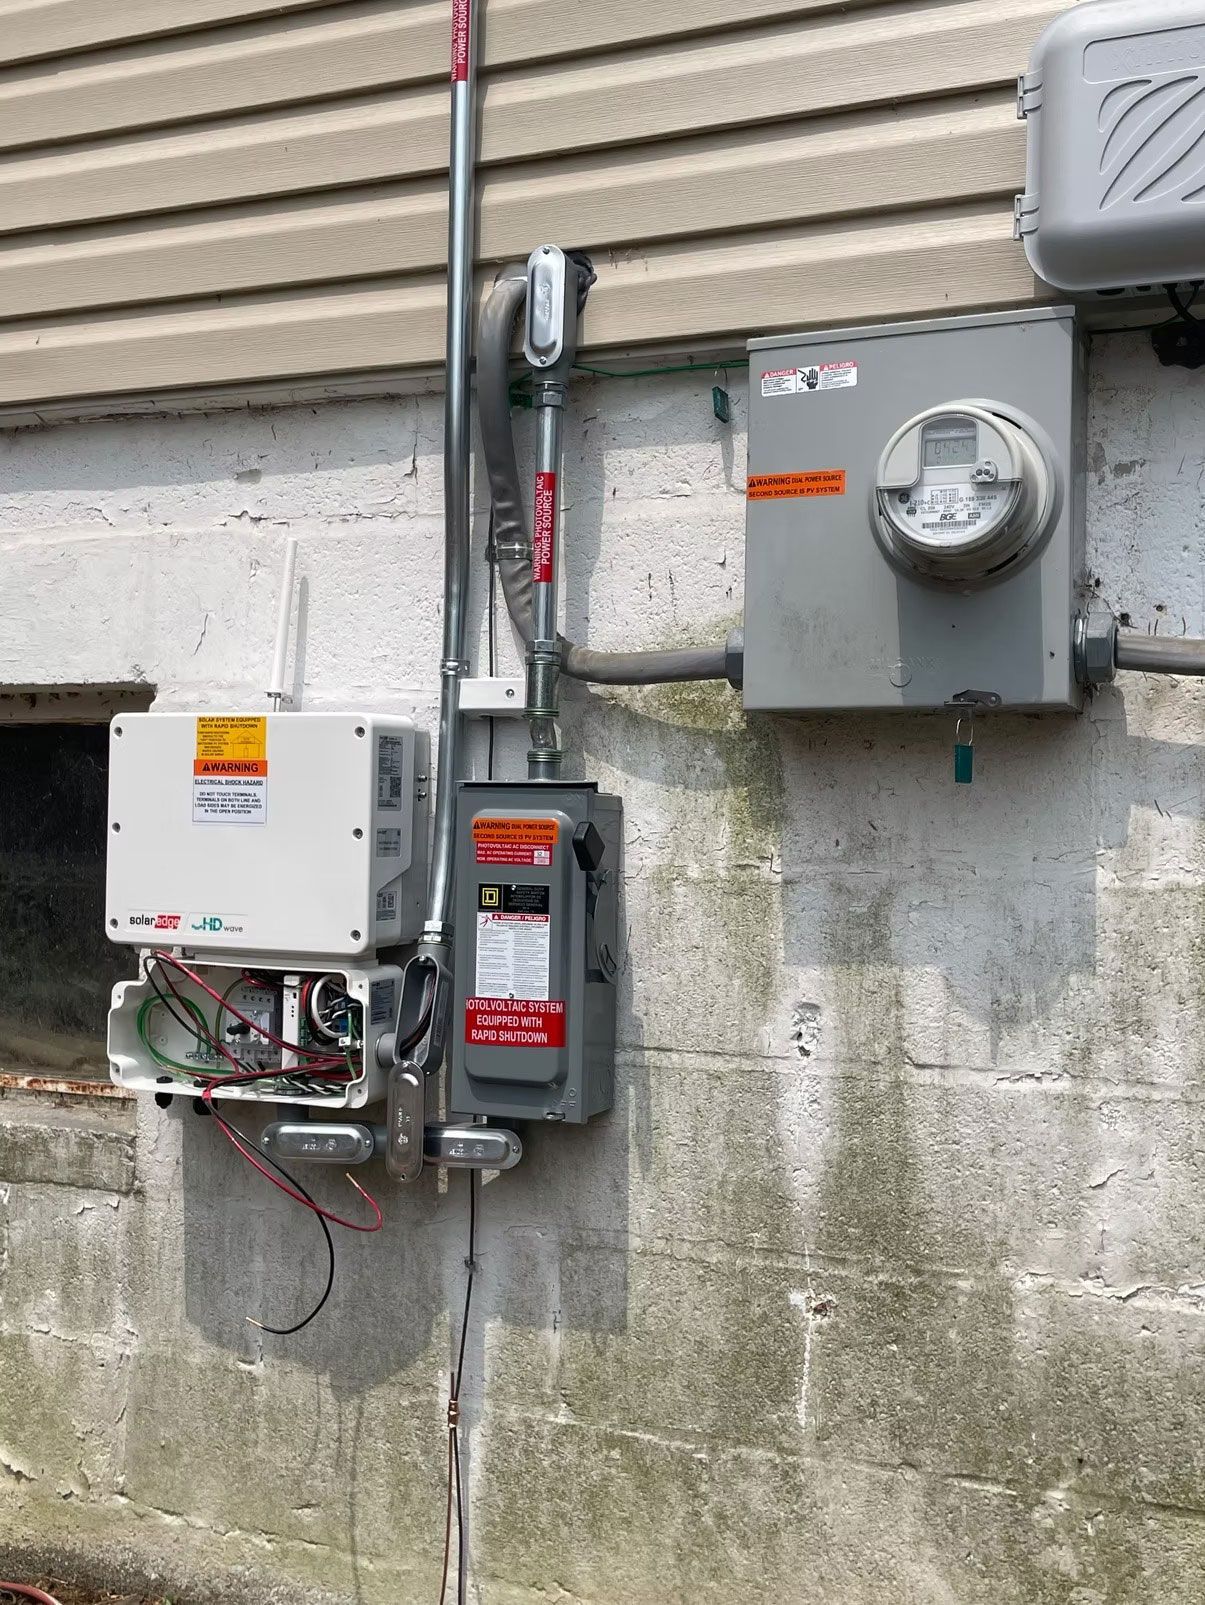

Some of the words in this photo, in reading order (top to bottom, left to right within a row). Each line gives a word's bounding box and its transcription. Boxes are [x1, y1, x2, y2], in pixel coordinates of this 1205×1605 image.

[457, 31, 466, 64] POWER
[829, 361, 854, 370] PELIGRO
[770, 370, 794, 378] DANGER
[756, 477, 790, 487] WARNING
[792, 476, 804, 484] DUAL
[823, 474, 842, 482] SOURCE
[748, 490, 772, 498] SECOND
[535, 476, 544, 538] PHOTOVOLTAIC
[543, 490, 552, 529] SOURCE
[940, 512, 958, 521] BGE
[542, 530, 551, 564] POWER
[533, 539, 542, 580] WARNING:
[211, 764, 258, 772] WARNING
[480, 822, 510, 830] WARNING
[203, 917, 222, 931] HD
[528, 1002, 563, 1013] SYSTEM
[476, 1015, 519, 1026] EQUIPPED
[520, 1016, 542, 1027] WITH
[472, 1029, 497, 1041] RAPID
[499, 1030, 548, 1043] SHUTDOWN
